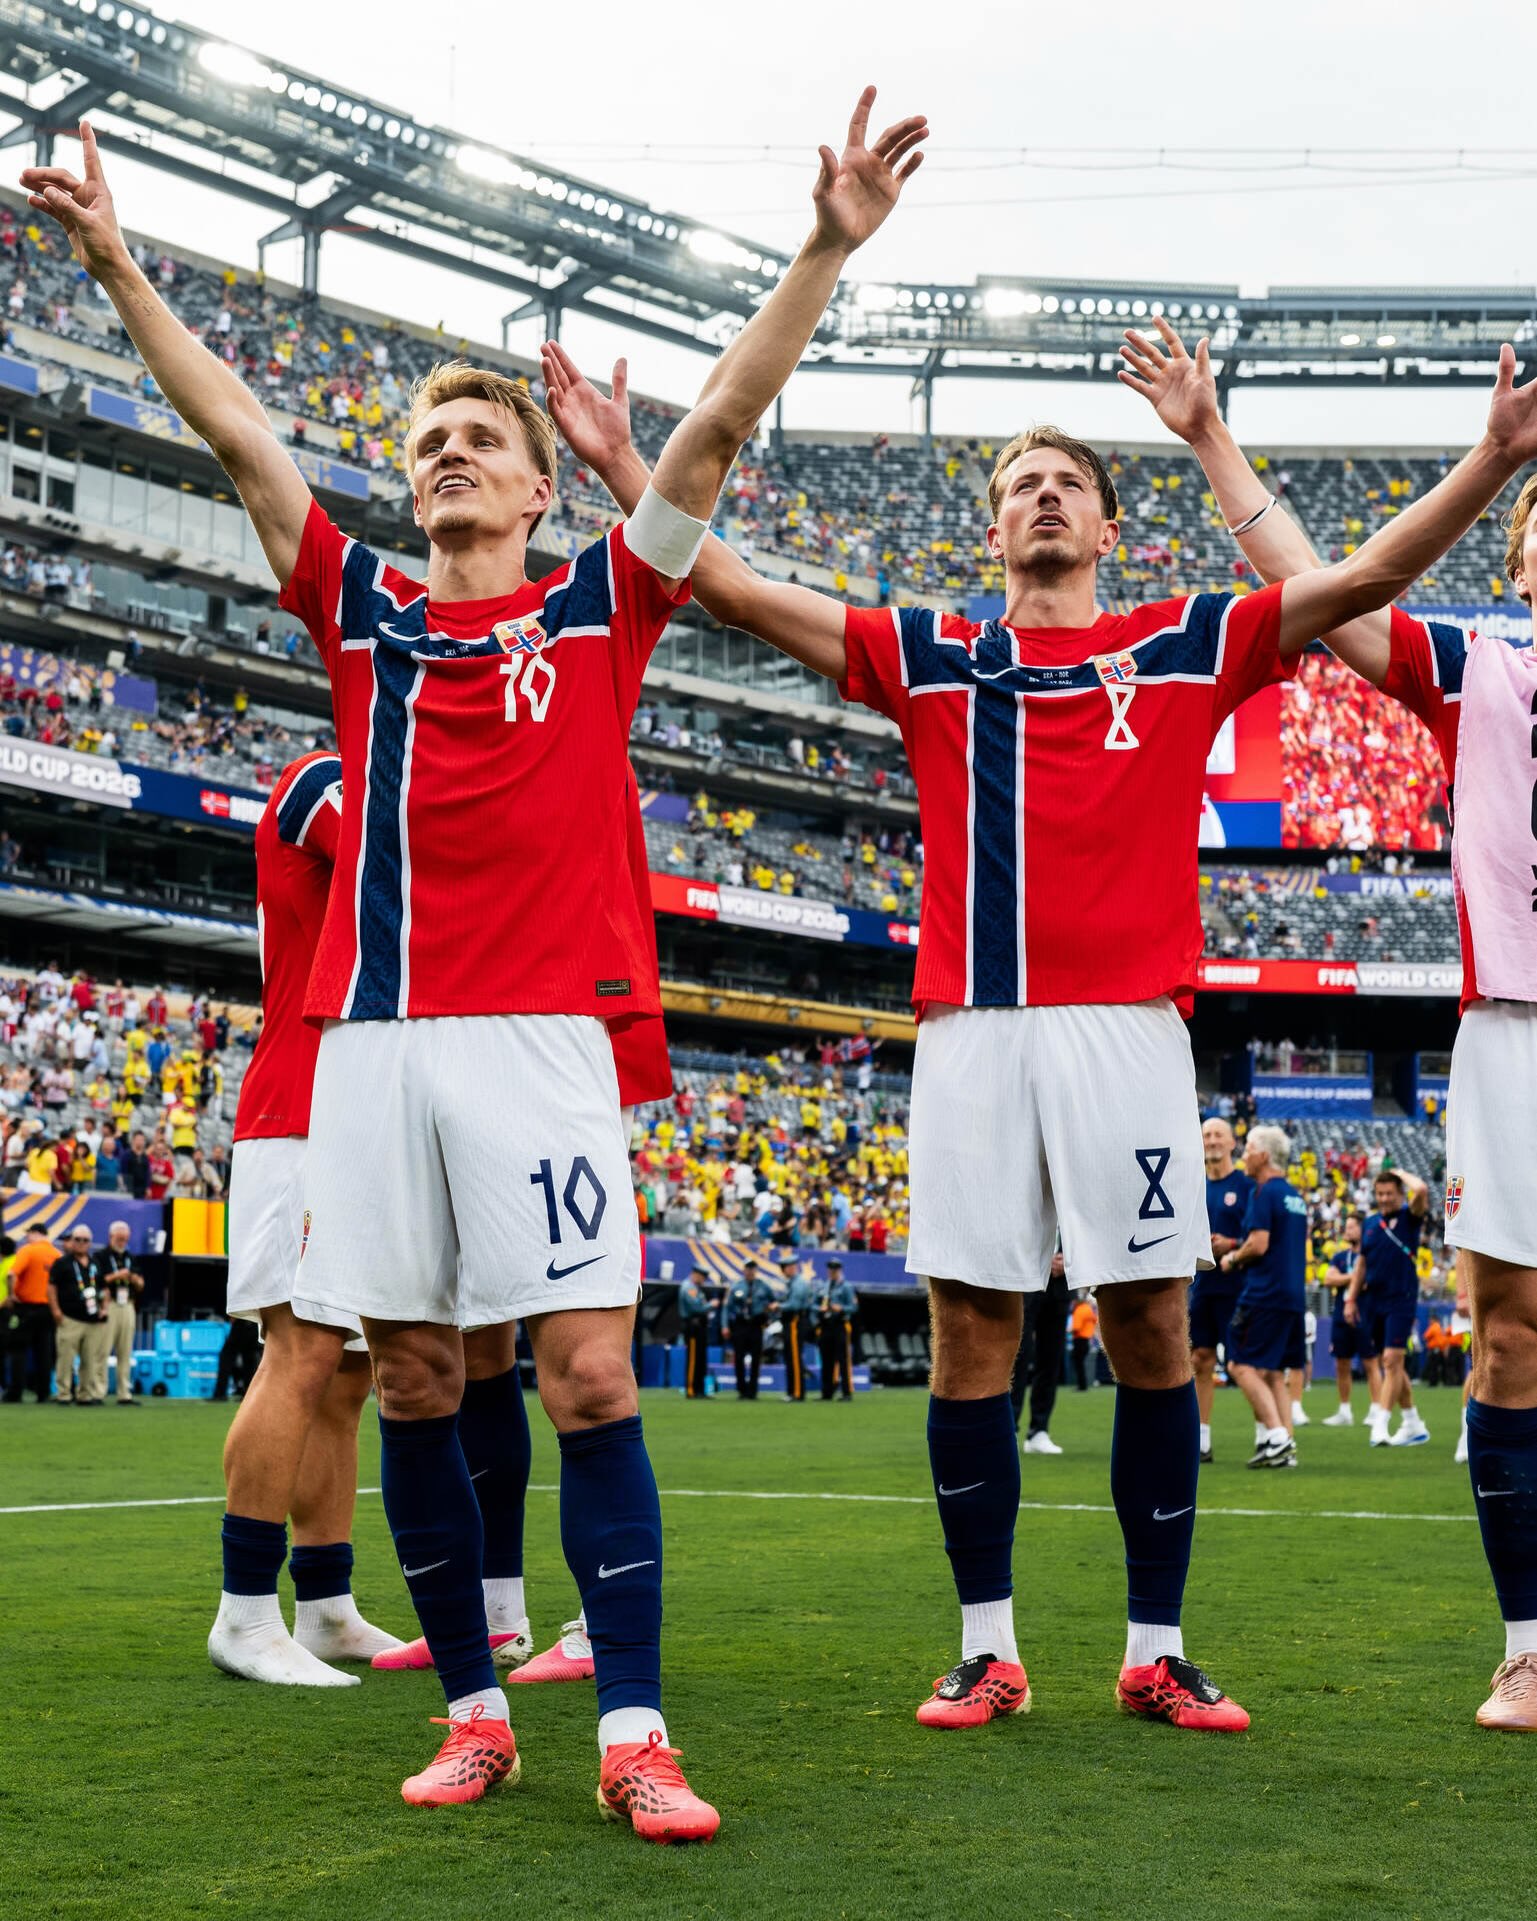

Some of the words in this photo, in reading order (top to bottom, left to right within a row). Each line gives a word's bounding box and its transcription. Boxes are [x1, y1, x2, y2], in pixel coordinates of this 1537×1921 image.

[499, 653, 557, 722] 10
[1104, 683, 1140, 750] 8
[0, 746, 28, 773] LD
[30, 753, 70, 782] CUP
[71, 762, 142, 799] 2026
[687, 888, 720, 911] FIFA
[720, 893, 771, 919] WORLD
[773, 903, 801, 924] CUP
[1361, 877, 1405, 896] FIFA
[1317, 967, 1358, 986] FIFA
[1359, 969, 1426, 988] WORLD
[530, 1156, 607, 1244] 10
[1135, 1147, 1175, 1220] 8
